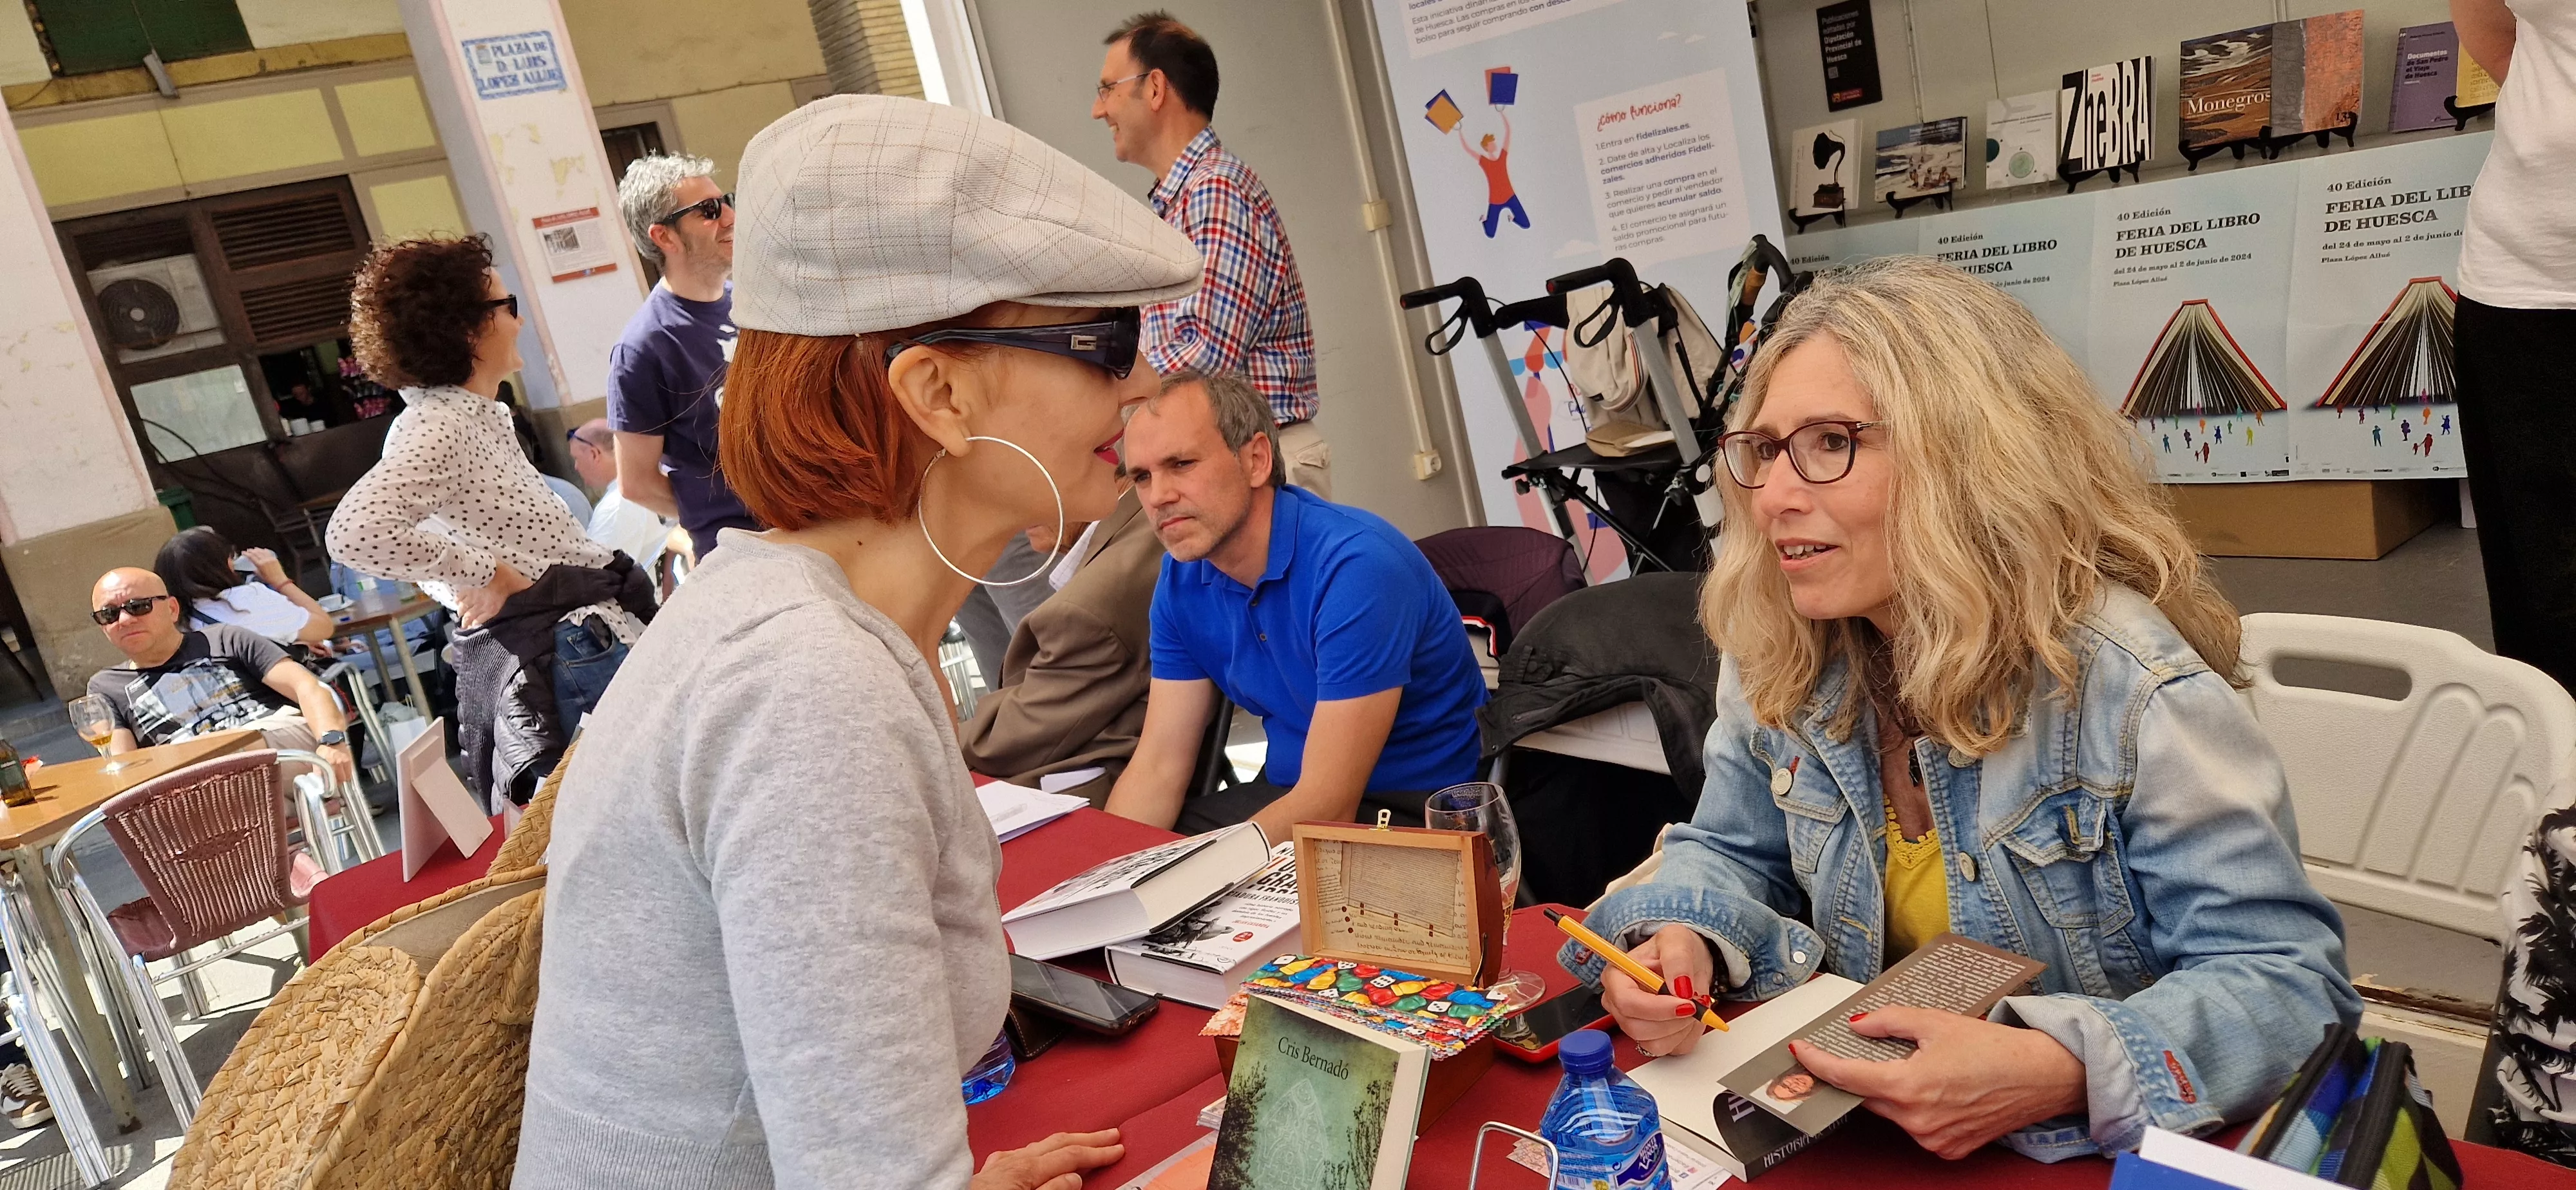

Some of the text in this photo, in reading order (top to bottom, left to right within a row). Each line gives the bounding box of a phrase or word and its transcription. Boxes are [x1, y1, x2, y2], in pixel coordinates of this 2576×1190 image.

[1412, 15, 1429, 25] Esta
[1430, 5, 1464, 20] iniciativa
[1416, 33, 1437, 44] bolso
[1437, 28, 1456, 40] para
[1456, 21, 1481, 35] seguir
[1482, 8, 1528, 27] comprando
[1530, 3, 1545, 12] con
[1426, 18, 1455, 32] Huesca.
[1456, 12, 1470, 23] Las
[1471, 5, 1505, 21] compras
[1824, 31, 1854, 44] Diputación
[1825, 42, 1853, 53] Provincial
[491, 40, 547, 57] PLAZA DE
[1826, 53, 1848, 64] Huesca
[2407, 50, 2448, 60] Documentos
[2186, 90, 2271, 116] Monegros
[1607, 154, 1626, 164] Date
[1628, 149, 1638, 158] de
[1640, 146, 1655, 156] alta
[1656, 145, 1662, 153] y
[1663, 137, 1696, 150] Localiza
[1698, 133, 1710, 142] los
[1624, 136, 1634, 144] en
[1600, 160, 1643, 175] comercios
[1645, 149, 1687, 165] adheridos
[1602, 174, 1625, 185] zales.
[1613, 184, 1644, 198] Realizar
[1646, 182, 1662, 191] una
[1663, 173, 1696, 188] compra
[1697, 170, 1708, 178] en
[2327, 176, 2392, 193] 40 Edición
[1607, 177, 1724, 209] comercio y pedir al vendedor
[2325, 184, 2475, 214] FERIA DEL LIB
[1608, 210, 1625, 219] que
[1625, 203, 1656, 216] quieres
[1657, 193, 1696, 208] acumular
[2117, 207, 2172, 222] 40 Edición
[1620, 223, 1628, 231] El
[1629, 214, 1667, 229] comercio
[1678, 205, 1714, 219] asignará
[2116, 212, 2261, 242] FERIA DEL LIBRO
[2324, 209, 2439, 233] DE HUESCA
[1613, 232, 1634, 243] saldo
[1636, 220, 1687, 238] promocional
[1688, 217, 1707, 228] para
[1951, 232, 1984, 243] Edición
[2339, 241, 2351, 249] 24
[2367, 238, 2391, 249] mayo
[2425, 230, 2452, 241] junio
[1937, 240, 2058, 262] FERIA DEL LIBRO
[2115, 238, 2208, 259] DE HUESCA
[2344, 253, 2367, 263] López
[1801, 254, 1830, 264] Edición
[2148, 263, 2168, 272] mayo
[2196, 257, 2218, 267] junio
[2230, 253, 2252, 262] 2024
[2003, 279, 2022, 288] junio
[2032, 275, 2050, 283] 2024
[1278, 1036, 1349, 1080] Cris Bernadó
